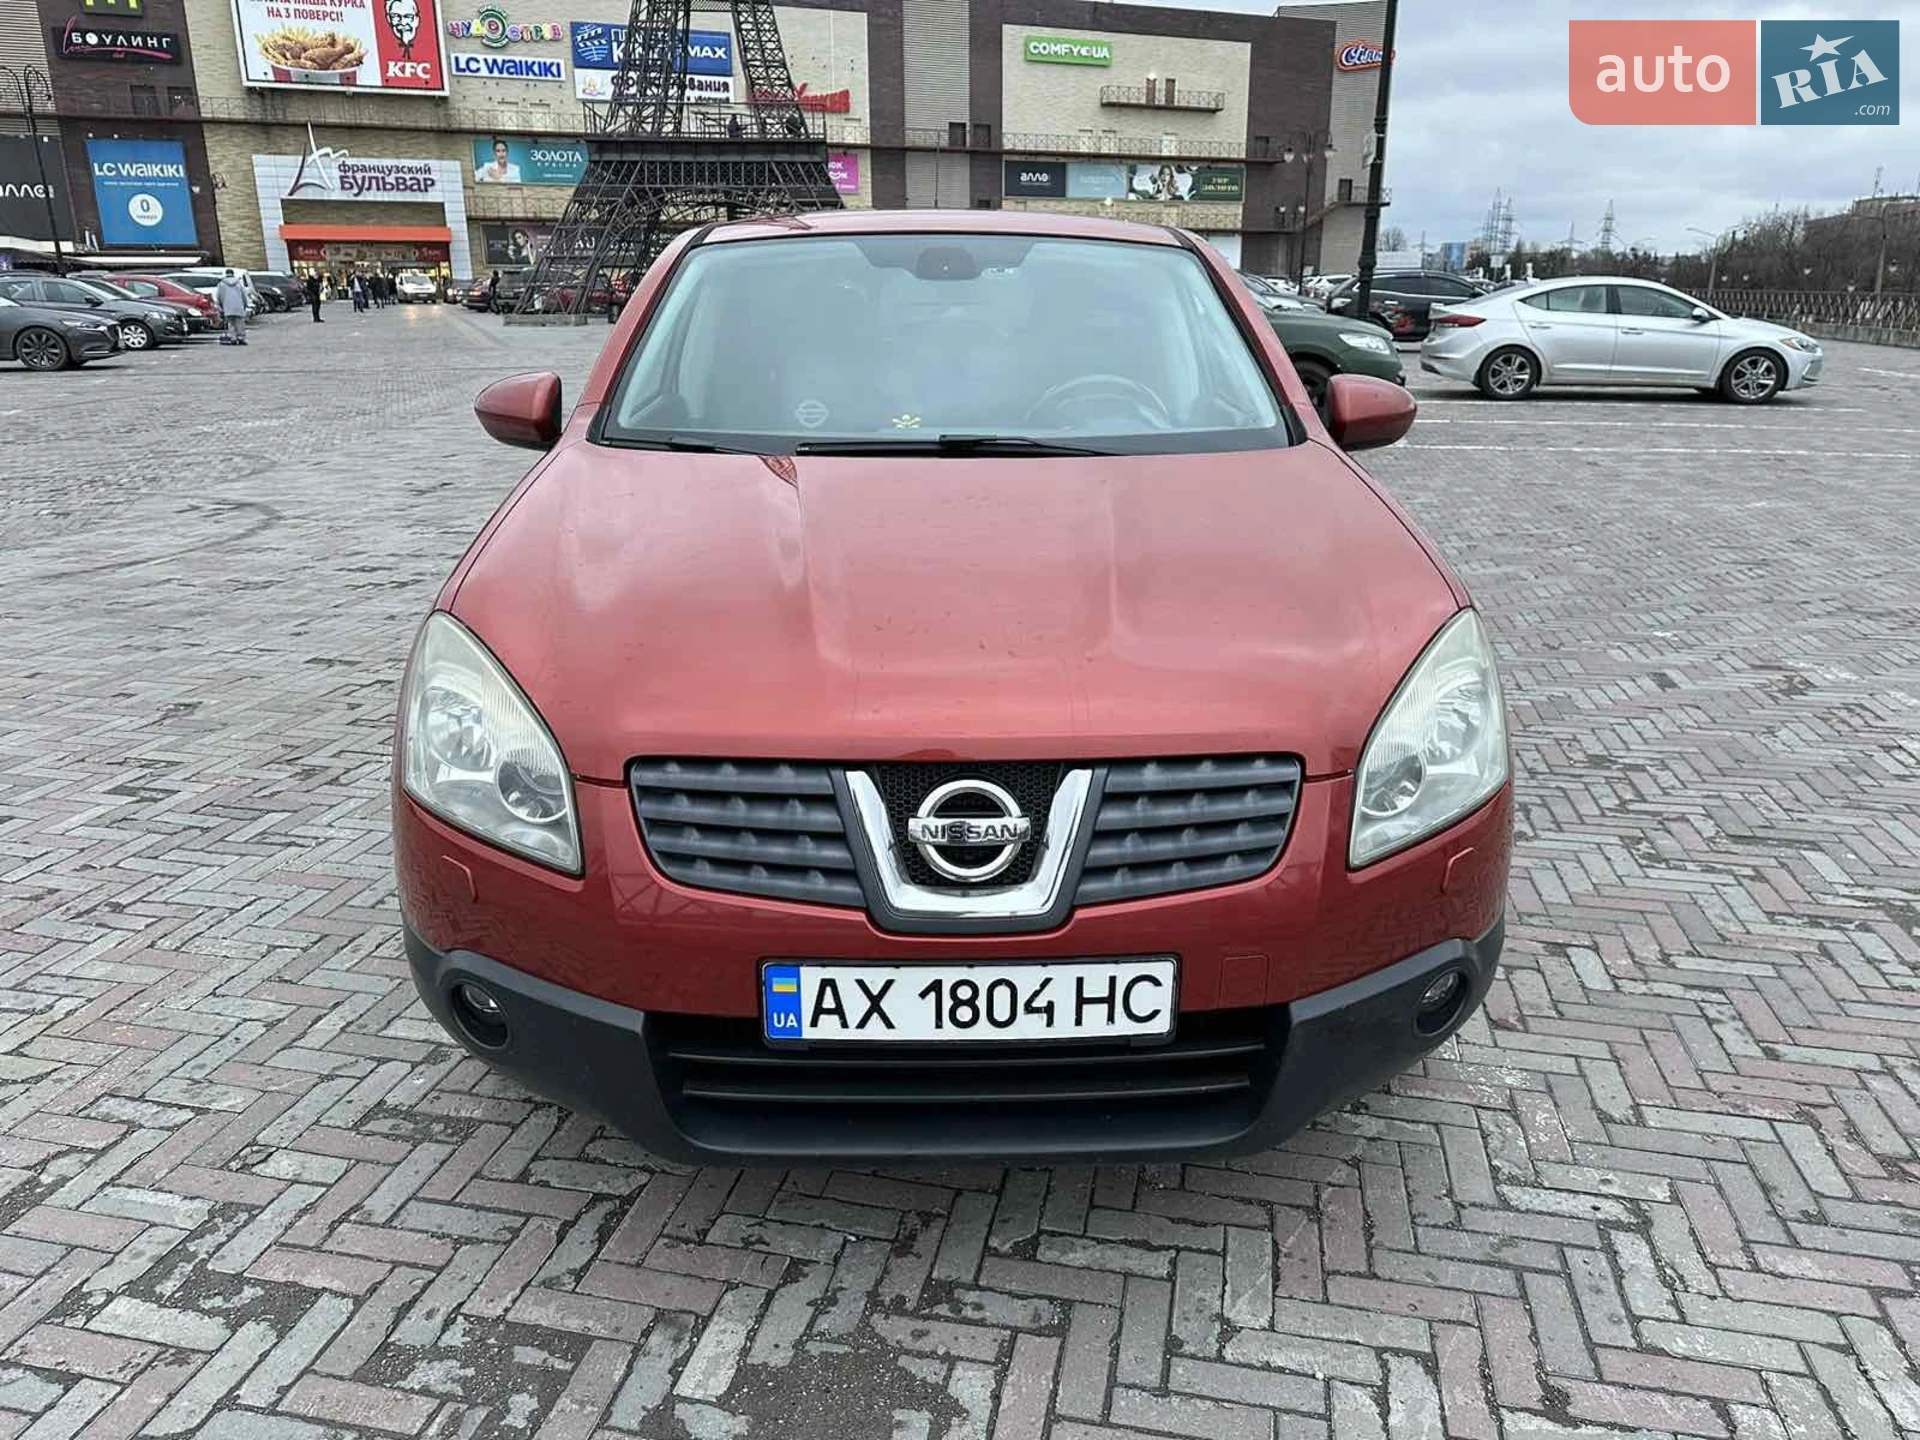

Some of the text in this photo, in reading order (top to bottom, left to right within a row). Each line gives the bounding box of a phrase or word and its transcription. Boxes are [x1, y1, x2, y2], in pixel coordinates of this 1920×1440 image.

[267, 7, 344, 22] НА 3 ПОВЕРСІ!
[387, 61, 431, 79] KFC
[454, 55, 480, 74] LC
[529, 149, 583, 163] ЗОЛОТА
[93, 162, 117, 177] LC
[338, 160, 432, 176] французский
[920, 823, 1018, 841] NISSAN
[809, 973, 1163, 1030] AX 1804 HC
[772, 1012, 799, 1028] UA
